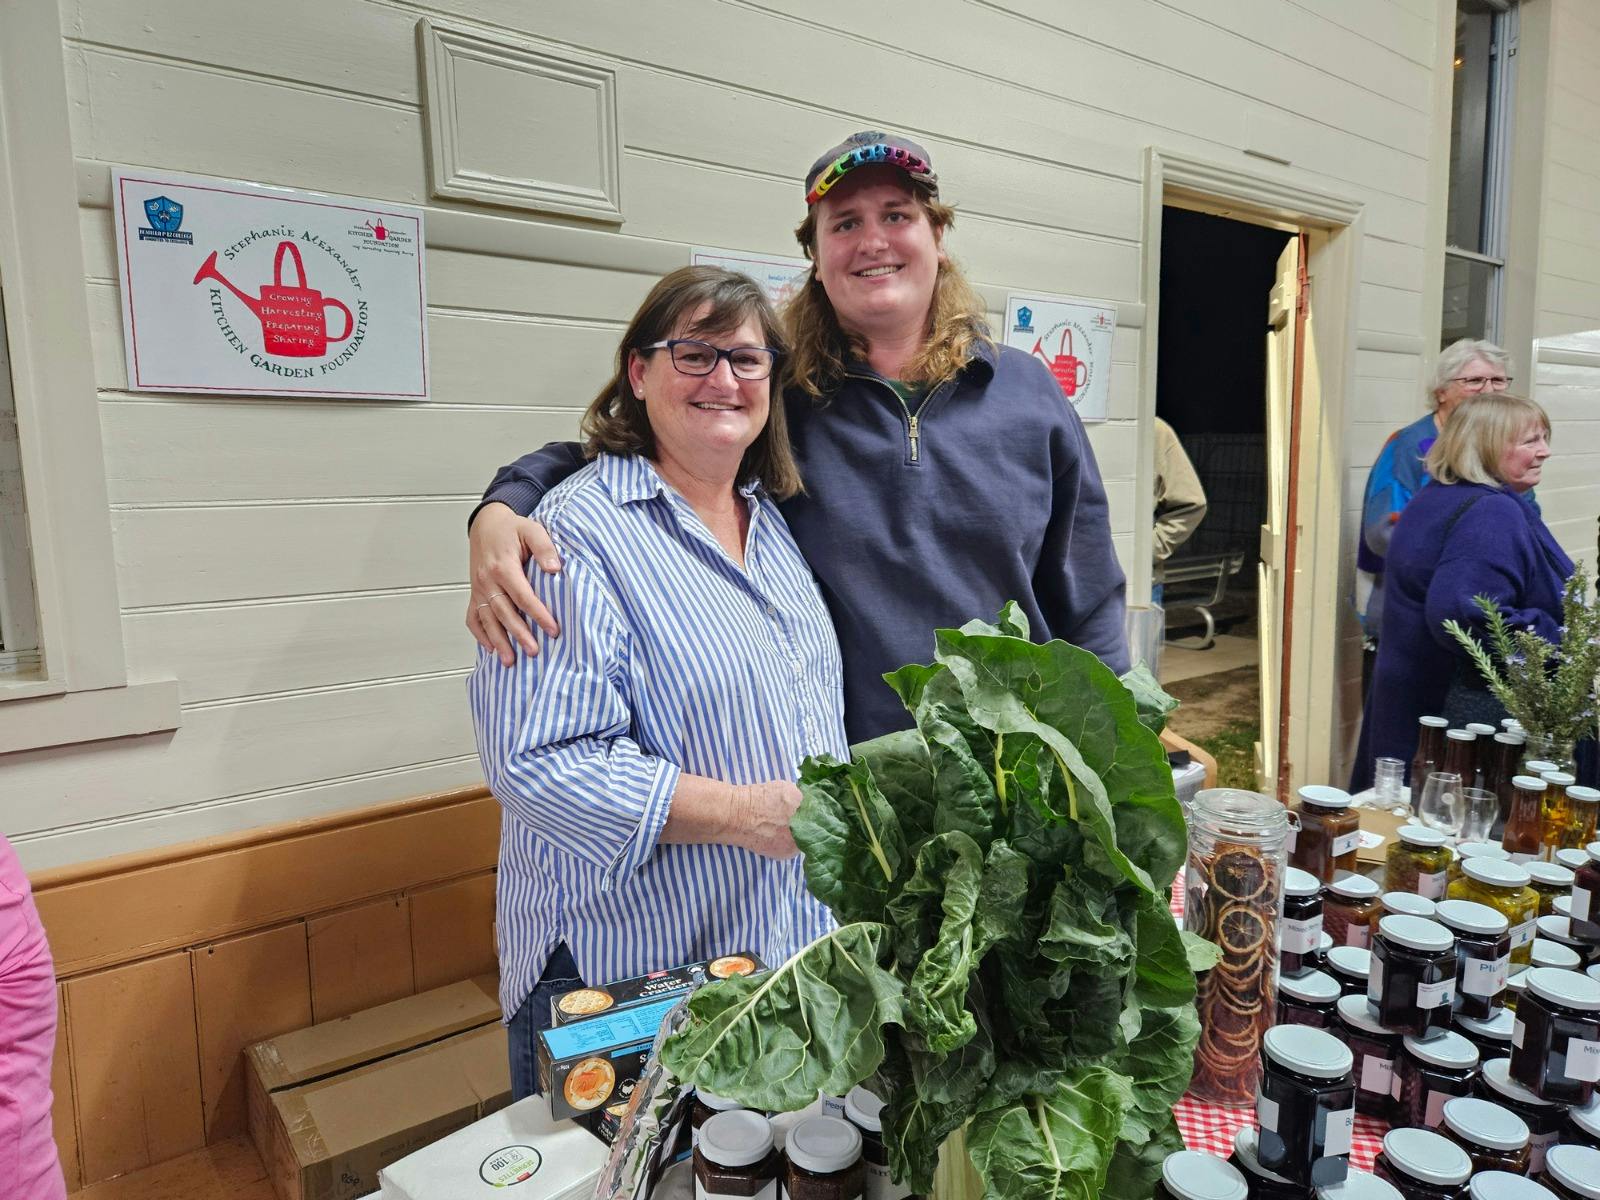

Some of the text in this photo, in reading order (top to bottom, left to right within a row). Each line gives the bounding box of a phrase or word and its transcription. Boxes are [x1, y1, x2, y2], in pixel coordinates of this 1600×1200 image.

[224, 225, 363, 291] Stephanie Alexander
[210, 288, 368, 378] KITCHEN GARDEN FOUNDATION
[273, 335, 314, 347] Sharing
[644, 979, 682, 990] Wafer
[491, 1158, 509, 1171] 100
